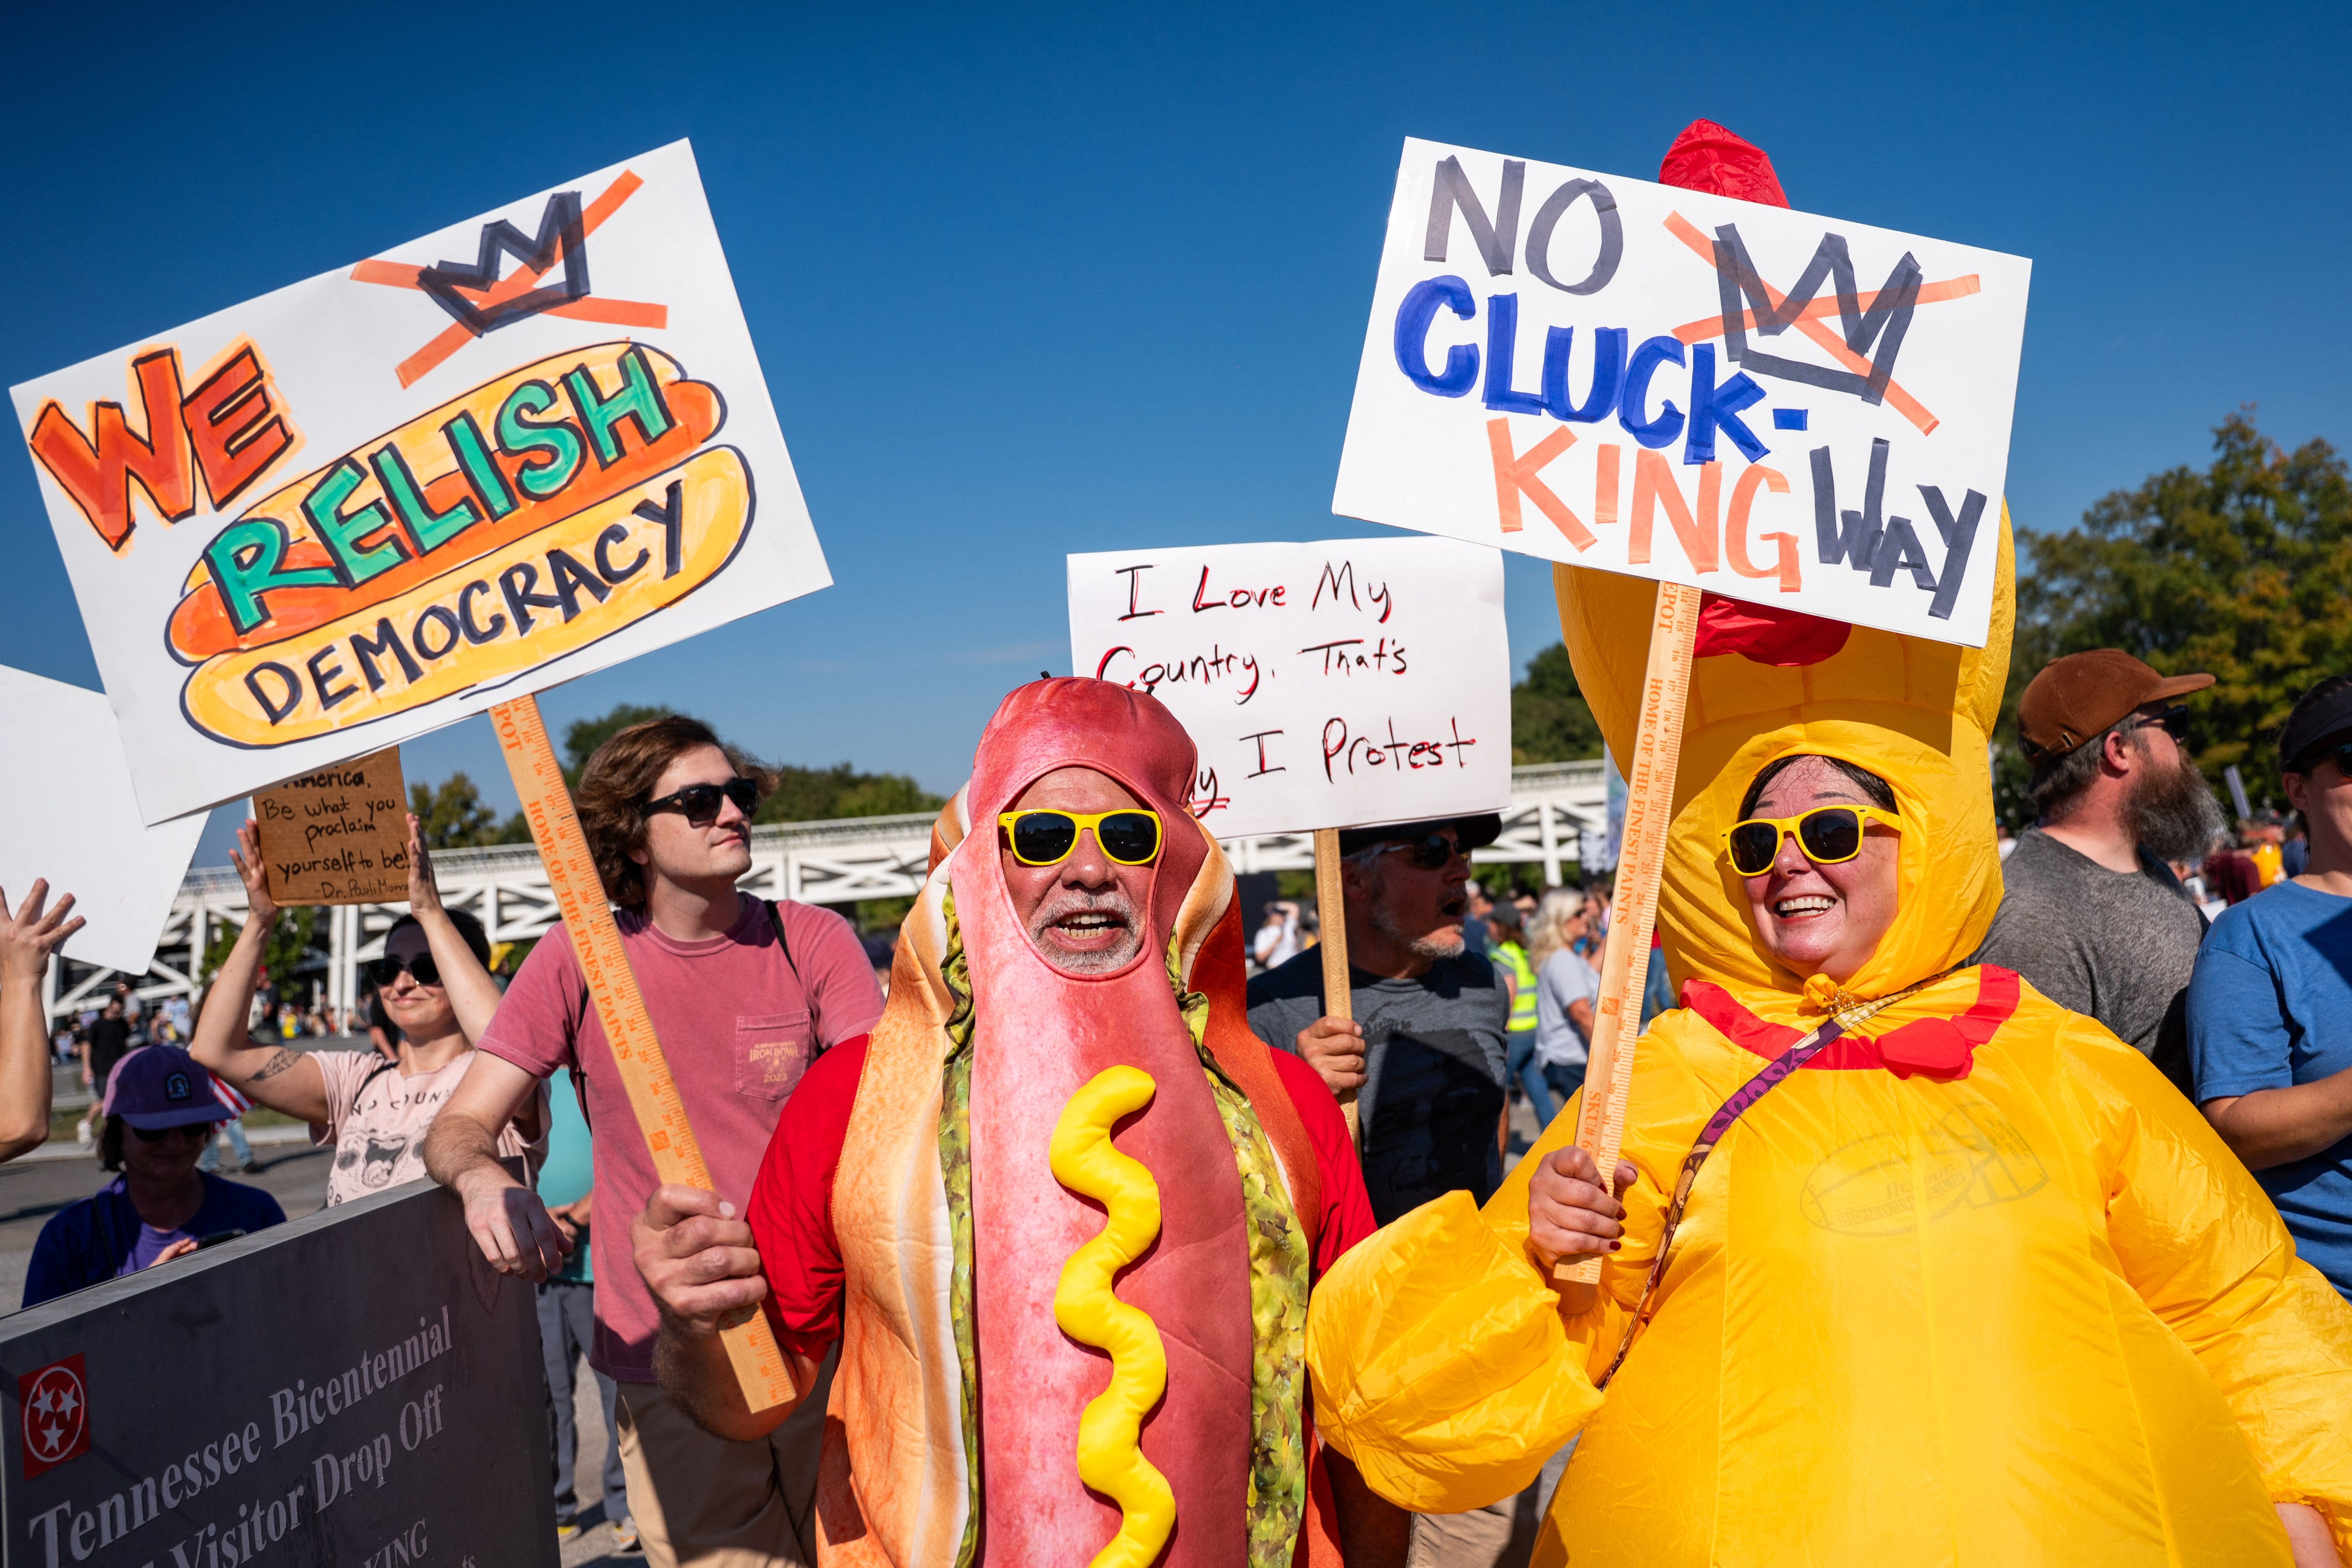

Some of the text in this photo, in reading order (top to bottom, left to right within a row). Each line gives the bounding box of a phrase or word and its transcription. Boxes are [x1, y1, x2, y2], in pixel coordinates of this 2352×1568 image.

[1423, 155, 1624, 295] NO
[1394, 275, 1808, 464] CLUCK-
[31, 341, 294, 550] WE
[204, 344, 676, 636] RELISH
[1487, 417, 1986, 620] KING WAY
[244, 481, 681, 724] DEMOCRACY
[1115, 561, 1391, 623] I Love My
[1659, 581, 1679, 634] EPOT
[1676, 620, 1685, 632] 15
[1297, 638, 1406, 675] That's
[1672, 650, 1680, 662] 16
[1667, 679, 1676, 692] 17
[1663, 710, 1671, 722] 18
[493, 703, 523, 751] POT
[1239, 716, 1476, 784] I Protest
[1660, 739, 1667, 752] 19
[1655, 769, 1663, 782] 20
[262, 796, 395, 820] Be what you
[1616, 677, 1663, 925] HOME OF THE FINEST PAINTS
[1650, 800, 1659, 812] 21
[305, 815, 377, 853] proclaim
[1645, 831, 1654, 844] 22
[276, 841, 410, 885] yourself to be!
[1641, 861, 1649, 875] 23
[348, 879, 377, 897] Pauli
[378, 879, 409, 895] Murra
[522, 731, 533, 743] 15
[533, 762, 542, 776] 16
[556, 827, 567, 840] 18
[568, 859, 579, 872] 19
[580, 890, 591, 904] 20
[603, 954, 614, 968] 22
[615, 987, 626, 999] 23
[638, 1049, 649, 1063] 25
[1637, 892, 1645, 906] 24
[529, 800, 633, 1060] HOME OF THE FINEST PAINTS
[1632, 923, 1640, 937] 25
[1627, 955, 1635, 967] 26
[1622, 986, 1630, 999] 27
[1617, 1018, 1626, 1031] 28
[750, 1046, 800, 1062] IRON BOWL
[1612, 1049, 1621, 1063] 29
[1607, 1080, 1616, 1094] 30
[1583, 1091, 1602, 1137] SKU#
[1602, 1112, 1611, 1125] 31
[1597, 1144, 1606, 1157] 32
[29, 1305, 452, 1568] Tennessee Bicentennial
[169, 1384, 444, 1568] Visitor Drop Off
